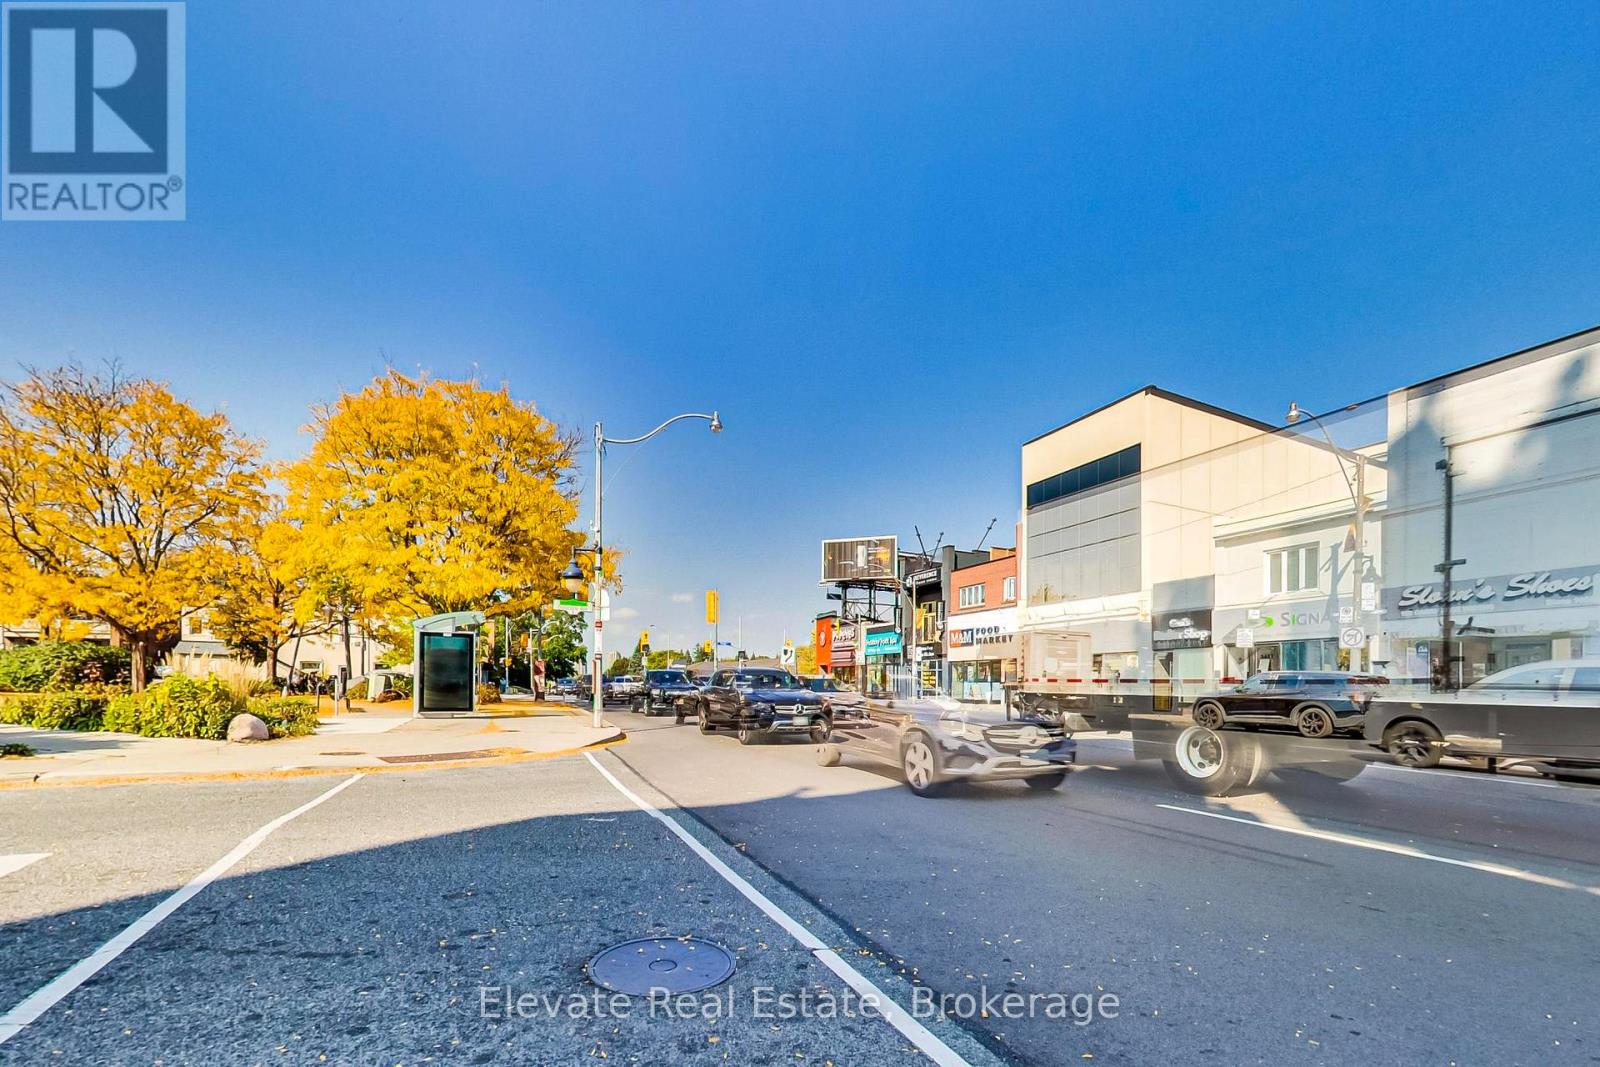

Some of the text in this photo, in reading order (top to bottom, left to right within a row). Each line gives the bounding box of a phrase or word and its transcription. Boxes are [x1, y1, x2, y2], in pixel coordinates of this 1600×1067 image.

[1503, 572, 1593, 601] Shoes
[950, 626, 1000, 643] M&M FOOD
[975, 635, 1013, 645] MARKET
